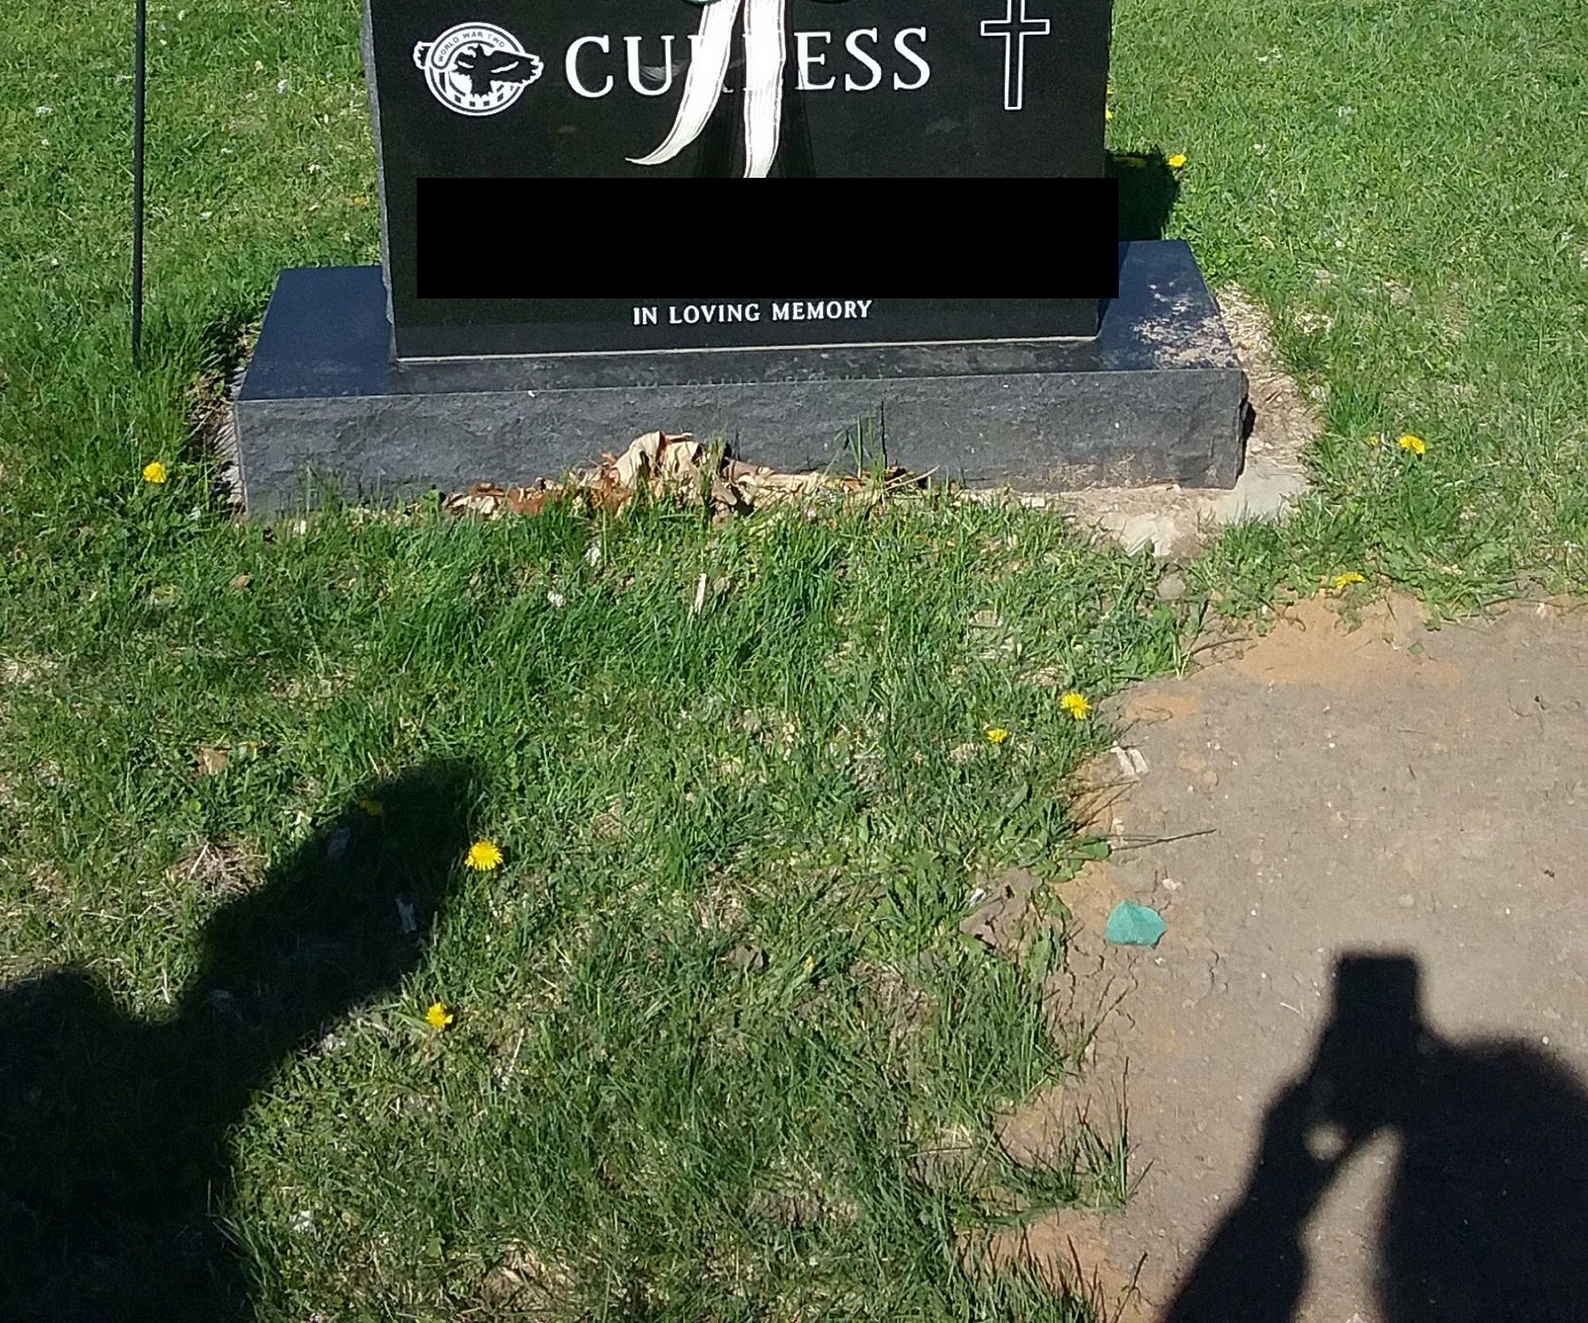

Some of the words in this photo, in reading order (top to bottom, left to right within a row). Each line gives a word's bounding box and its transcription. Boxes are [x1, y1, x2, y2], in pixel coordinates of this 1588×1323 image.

[437, 36, 460, 63] WORLD
[462, 30, 484, 40] WAR
[486, 33, 506, 48] TWO
[564, 25, 932, 99] CUESS
[632, 305, 659, 326] IN
[668, 302, 761, 325] LOVING
[771, 299, 874, 322] MEMORY
